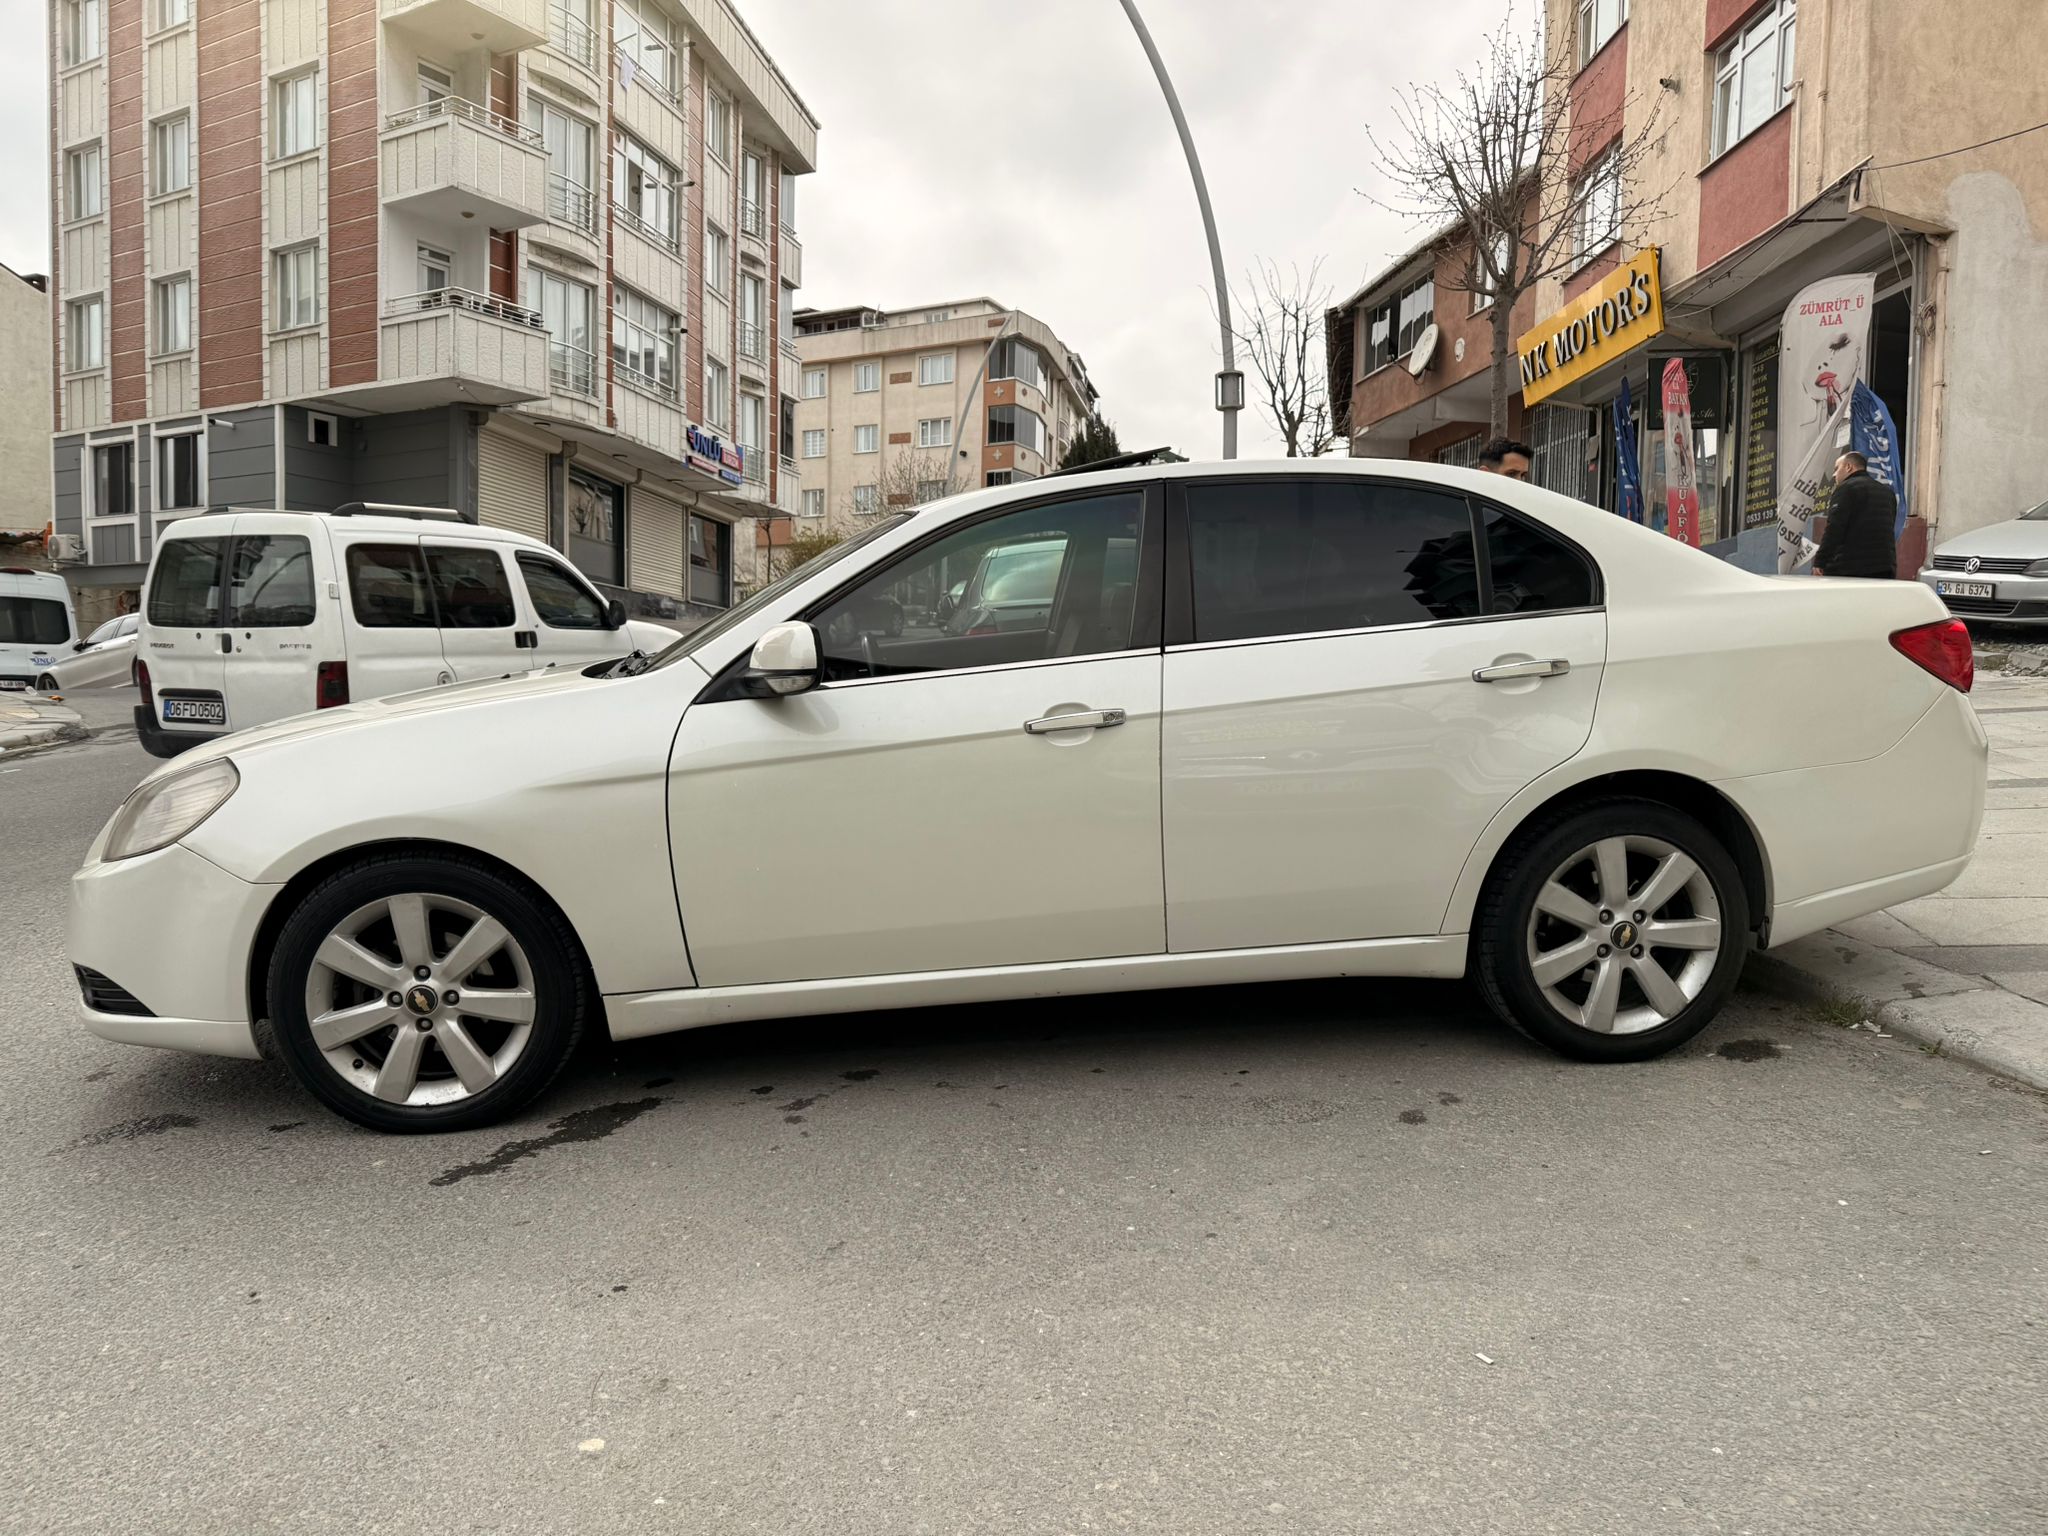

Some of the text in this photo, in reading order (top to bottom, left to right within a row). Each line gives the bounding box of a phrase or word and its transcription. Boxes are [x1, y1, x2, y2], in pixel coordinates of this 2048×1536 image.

[1819, 314, 1843, 327] ALA
[1520, 269, 1650, 387] NK MOTOR'S
[1668, 391, 1687, 405] BAYAN
[691, 424, 721, 461] ÜNLÜ
[1955, 584, 1965, 594] GA
[1968, 584, 1990, 596] 6374
